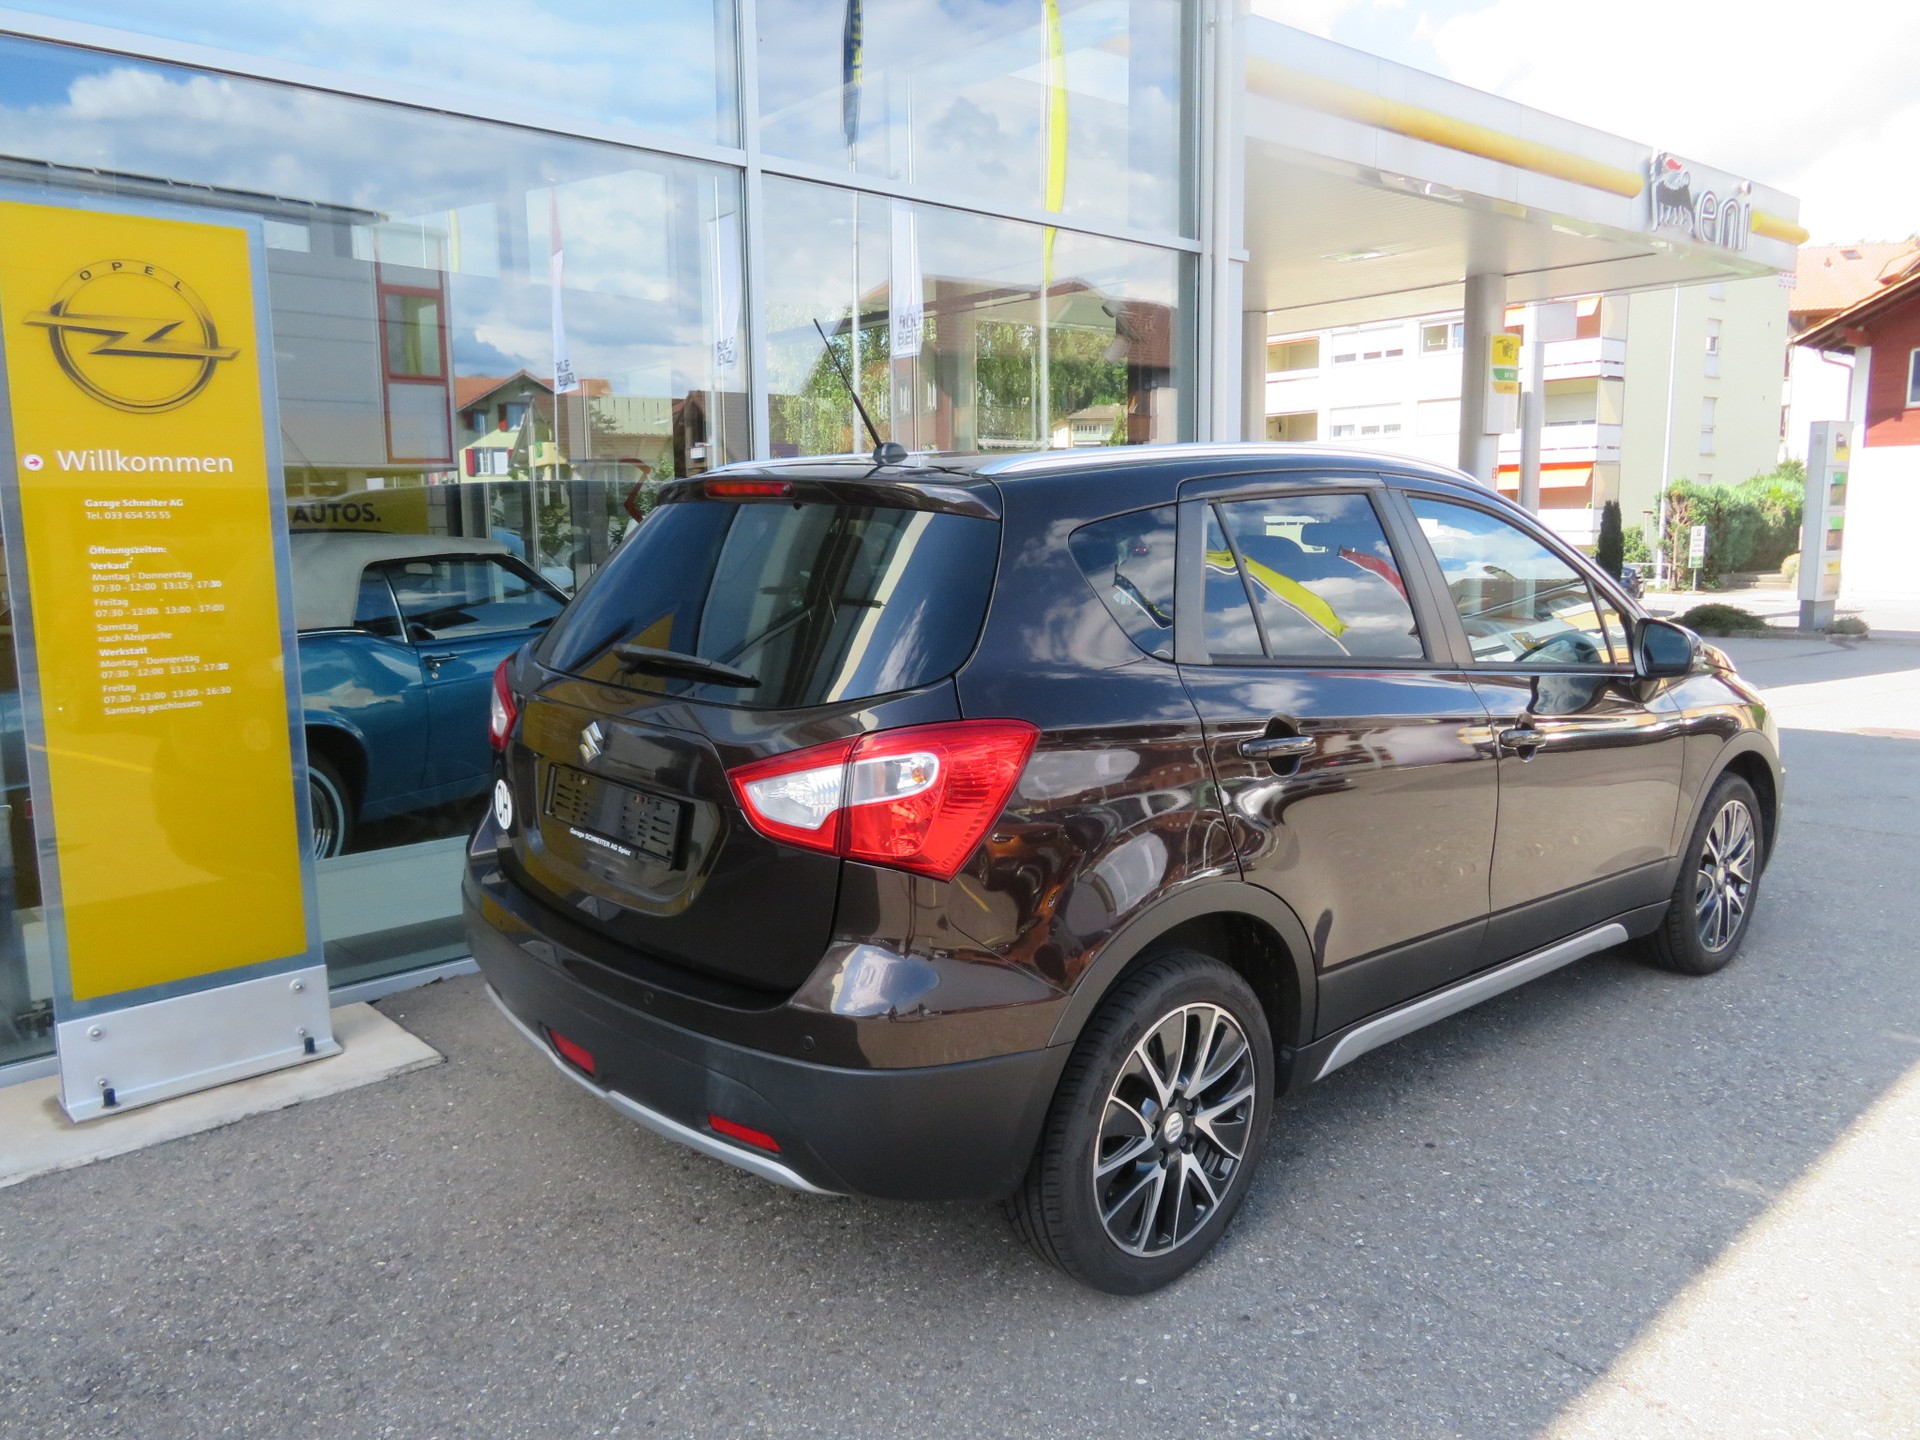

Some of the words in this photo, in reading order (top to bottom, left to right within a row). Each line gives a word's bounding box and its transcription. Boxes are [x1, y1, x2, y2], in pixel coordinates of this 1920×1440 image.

[1694, 181, 1752, 251] eni
[79, 261, 183, 292] OPEL
[56, 450, 234, 472] Willkommen
[84, 499, 121, 509] Garage
[122, 499, 167, 508] Schneiter
[169, 499, 184, 507] AG
[86, 511, 102, 520] Tel.
[104, 511, 123, 519] 033
[125, 511, 143, 519] 654
[145, 511, 157, 519] 55
[159, 511, 171, 519] 55
[291, 502, 382, 522] AUTOS.
[90, 561, 130, 570] Verkauf
[92, 573, 131, 582] Montag
[138, 571, 193, 580] Donnerstag
[93, 584, 121, 592] 07:30
[130, 583, 157, 591] 12:00
[163, 581, 189, 590] 13:15
[94, 599, 129, 607] Freitag
[95, 609, 123, 617] 07:30
[132, 607, 159, 616] 12:00
[165, 606, 192, 614] 13:00
[199, 604, 225, 613] 17:00
[97, 624, 139, 632] Samstag
[98, 634, 121, 643] nach
[124, 632, 173, 642] Absprache
[99, 647, 148, 656] Werkstatt
[100, 660, 139, 669] Montag
[146, 655, 200, 665] Donnerstag
[138, 667, 164, 676] 12:00
[102, 684, 137, 693] Freitag
[103, 695, 131, 704] 07:30
[140, 692, 166, 700] 12:00
[172, 689, 199, 698] 13:00
[104, 705, 146, 715] Samstag
[148, 700, 203, 713] geschlossen
